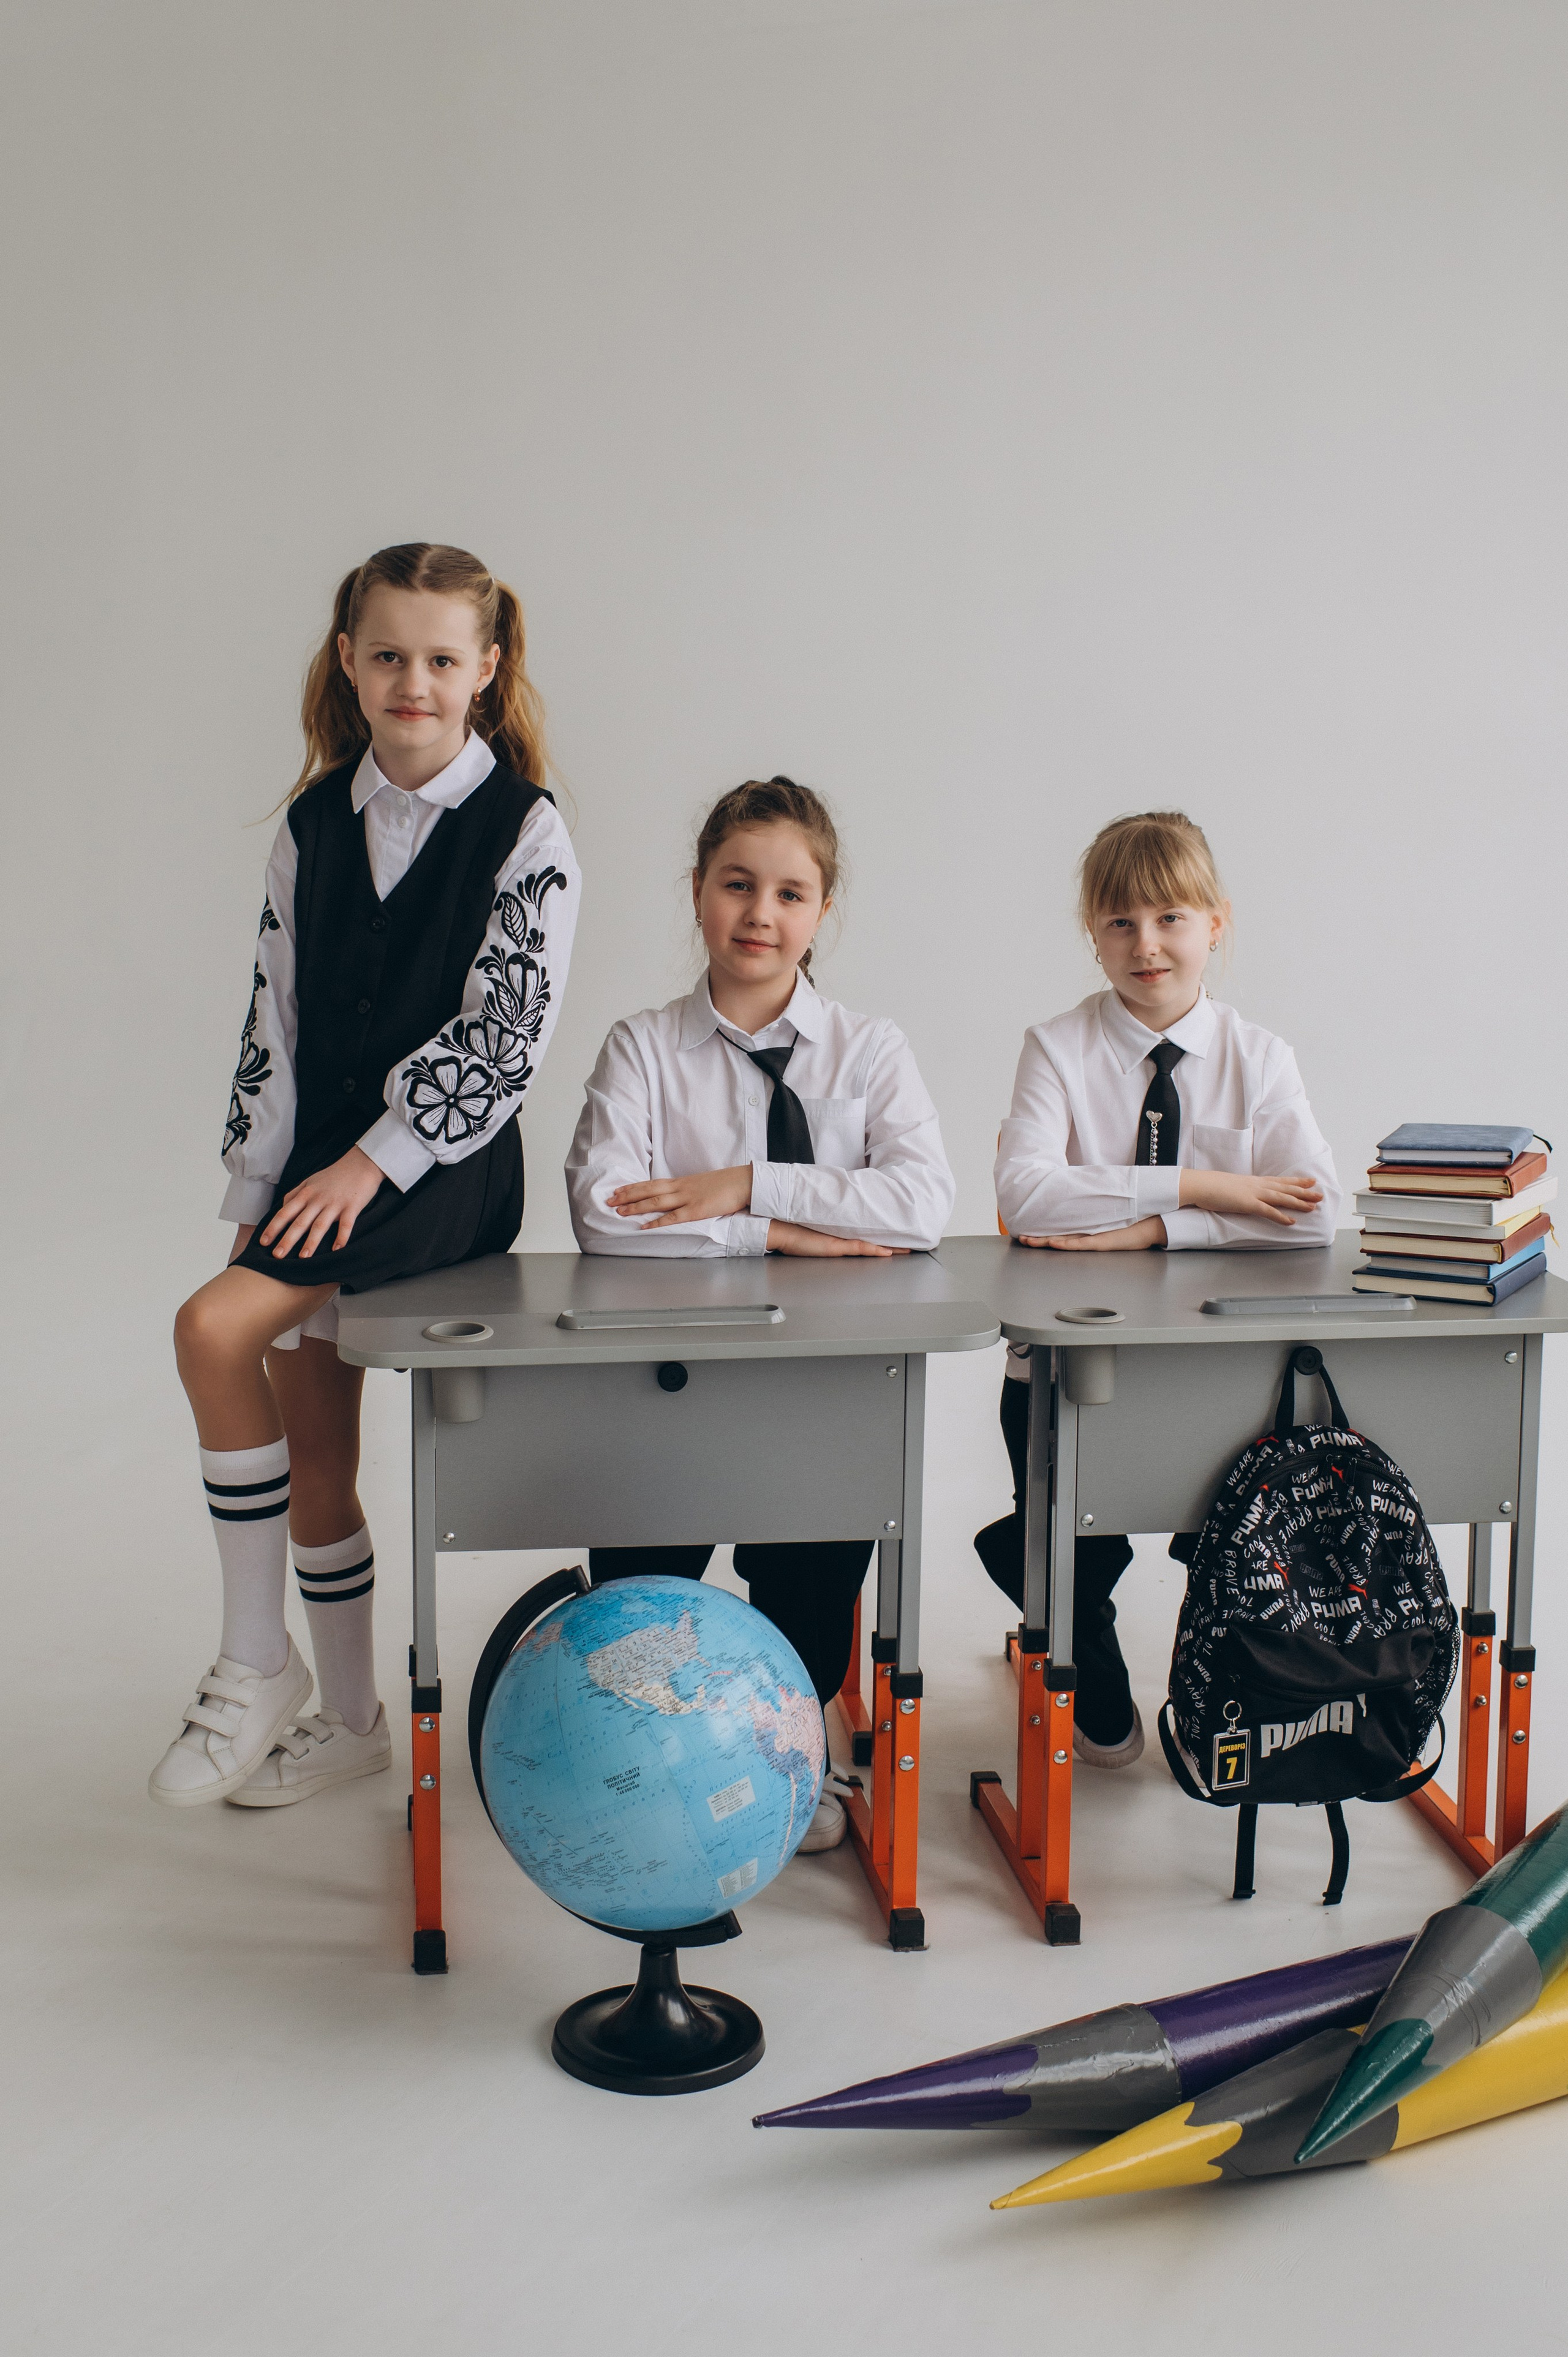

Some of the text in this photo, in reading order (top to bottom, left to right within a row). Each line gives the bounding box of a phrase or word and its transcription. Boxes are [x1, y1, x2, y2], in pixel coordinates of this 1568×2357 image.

[1310, 1431, 1363, 1449] PUMA
[1226, 1449, 1254, 1486] WE ARE
[1373, 1479, 1390, 1492] WE
[1231, 1493, 1264, 1545] PUMA
[1371, 1495, 1417, 1526] PUMA
[1278, 1506, 1313, 1544] BRAVE
[1340, 1521, 1357, 1544] PUMA
[1384, 1530, 1403, 1541] PUM
[1265, 1534, 1286, 1567] BRAVE
[1400, 1547, 1428, 1566] BRAV
[1224, 1550, 1240, 1596] BRAVE
[1325, 1553, 1345, 1583] PUMA
[1341, 1555, 1366, 1586] BRAVE
[1209, 1578, 1218, 1606] PUMA
[1243, 1573, 1285, 1591] UMA
[1308, 1585, 1326, 1598] WE
[1393, 1582, 1412, 1596] WE
[1234, 1605, 1257, 1622] RAVE
[1259, 1597, 1284, 1621] PUMA
[1283, 1593, 1295, 1614] COOL
[1310, 1596, 1362, 1619] PUMA
[1313, 1621, 1336, 1636] COOL
[1360, 1610, 1375, 1629] COOL
[1402, 1613, 1426, 1629] COOL
[1344, 1620, 1362, 1645] PUMA
[1193, 1658, 1212, 1683] PUMA
[1191, 1715, 1200, 1740] COOL
[1261, 1701, 1354, 1759] PUMA
[1219, 1743, 1246, 1754] ДЕРЕВОРІЗ
[603, 1766, 640, 1785] ГЛОБУС СВІТУ
[1226, 1757, 1238, 1780] 7
[607, 1772, 641, 1789] ПОЛІТИЧНИЙ
